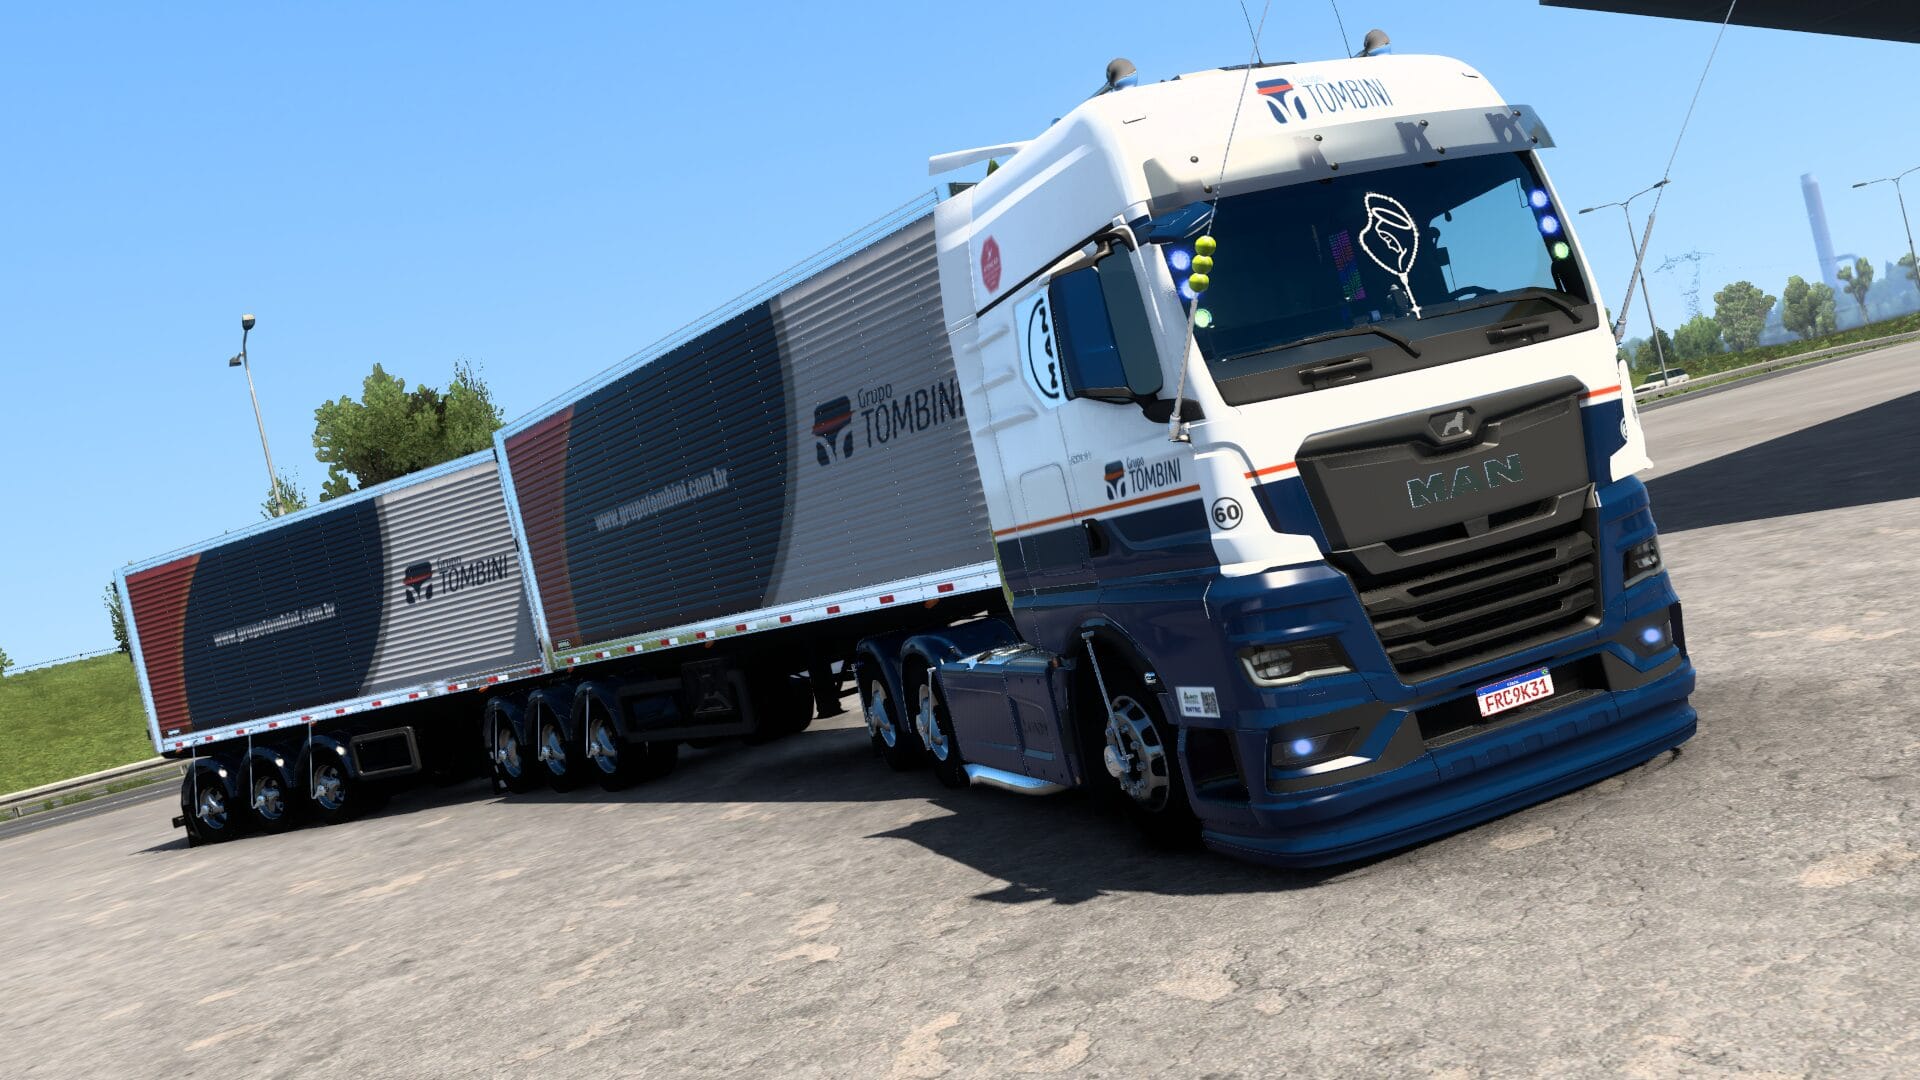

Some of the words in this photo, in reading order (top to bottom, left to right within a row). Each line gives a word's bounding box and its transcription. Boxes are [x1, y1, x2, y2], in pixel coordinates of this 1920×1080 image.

[1302, 79, 1393, 114] TOMBINI
[858, 384, 892, 408] Grupo
[1129, 457, 1181, 493] TOMBINI
[1406, 453, 1524, 509] MAN
[1214, 504, 1240, 523] 60
[440, 553, 508, 594] TOMBINI
[1485, 678, 1549, 712] FRC9K31
